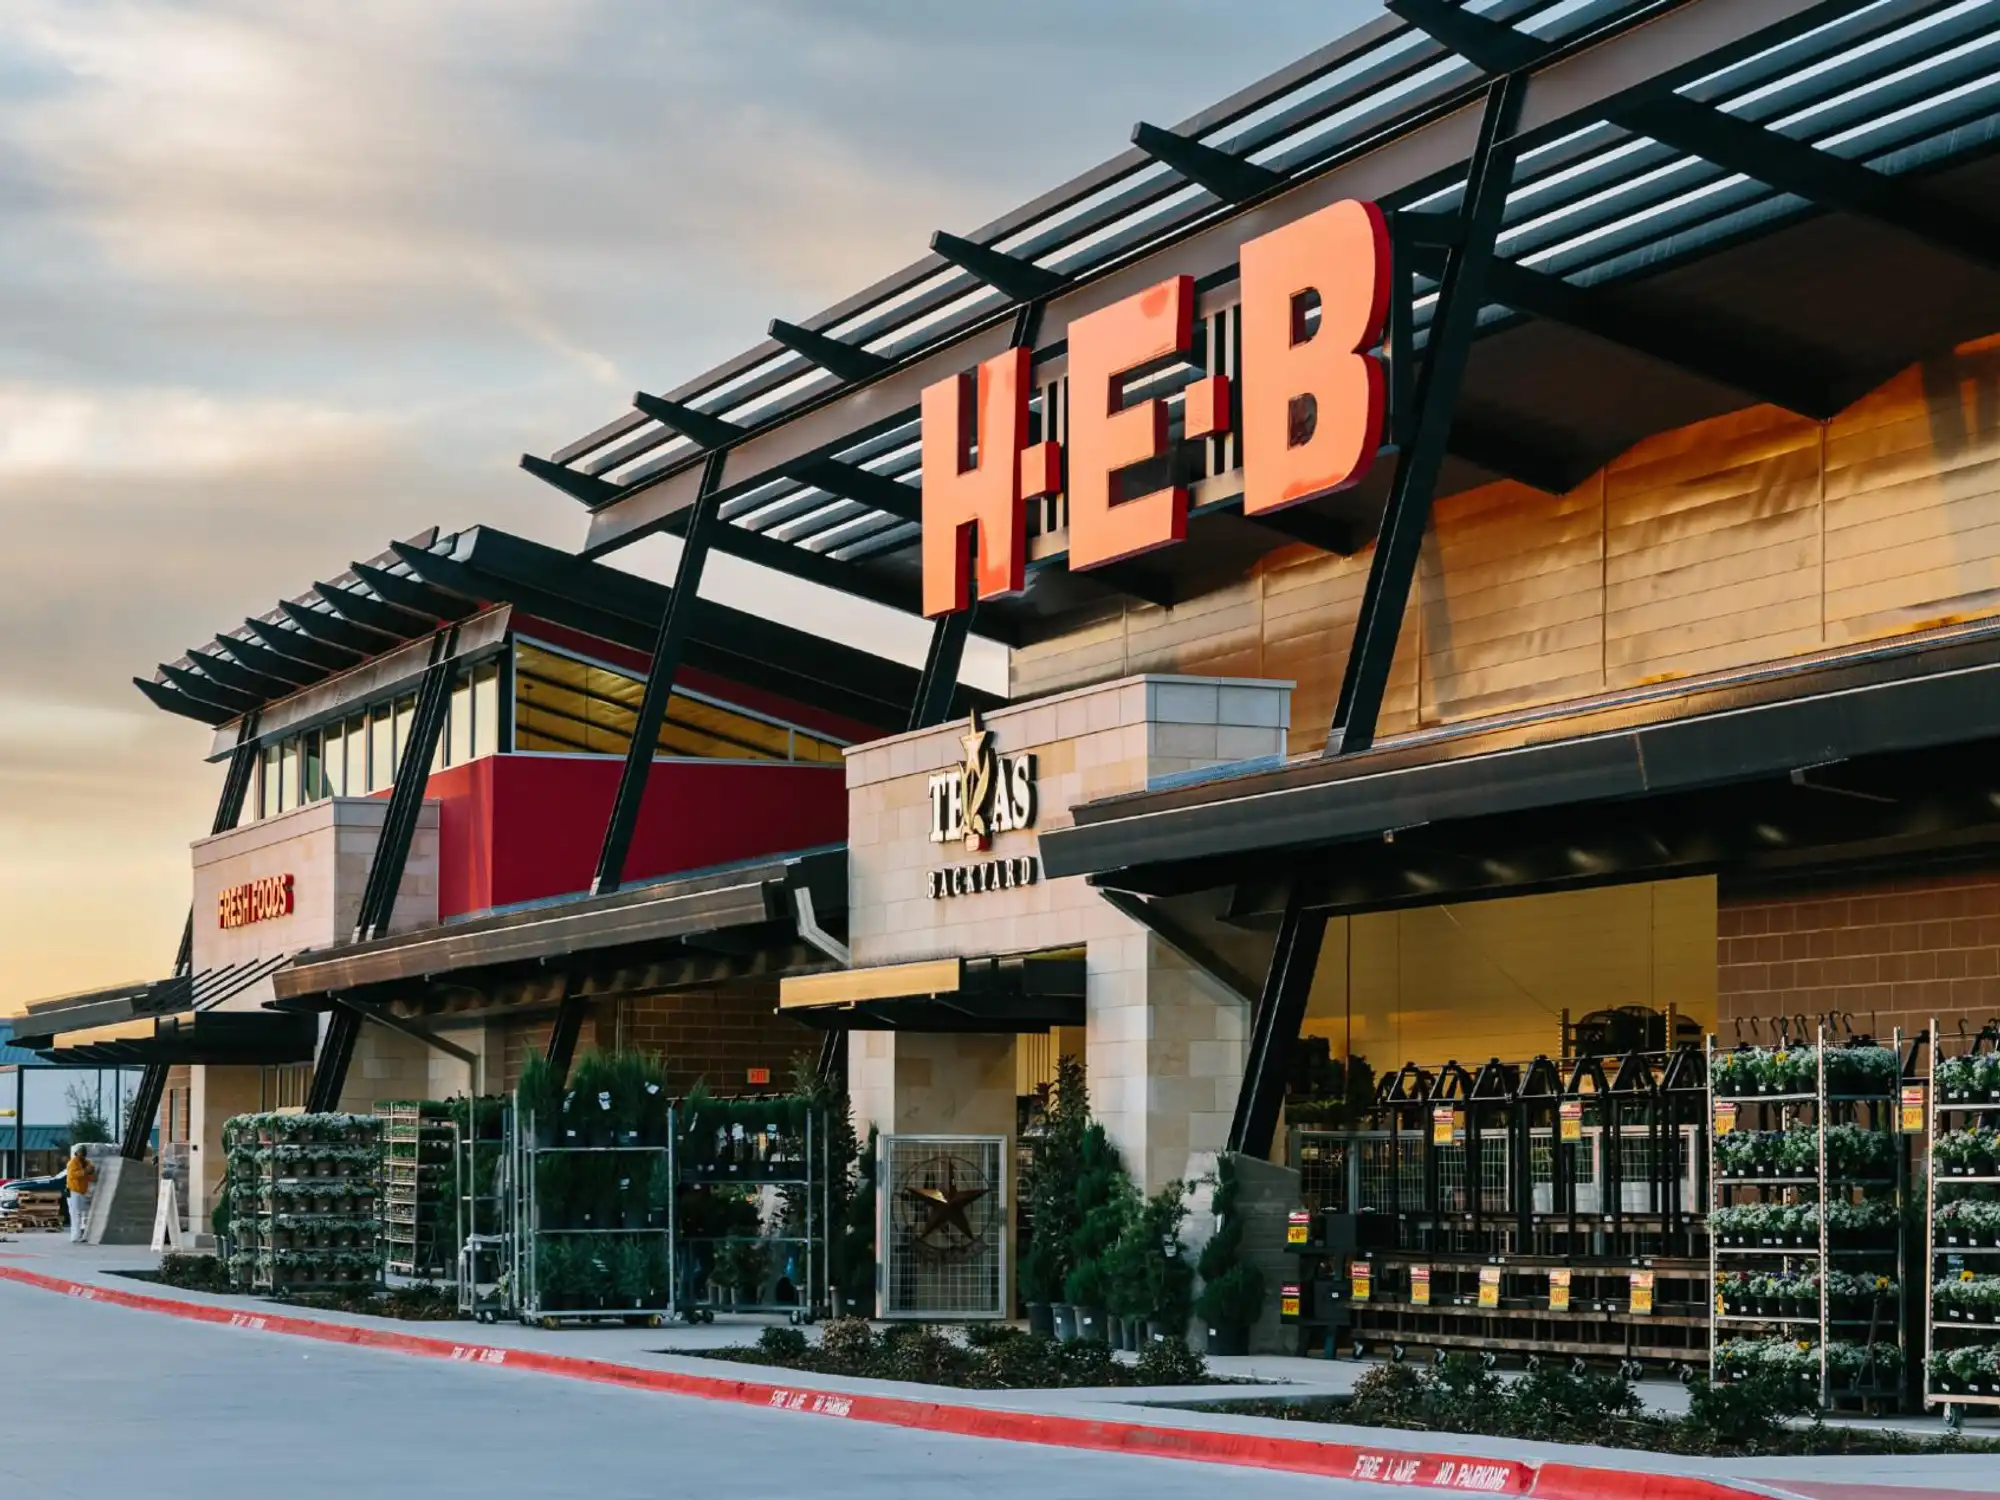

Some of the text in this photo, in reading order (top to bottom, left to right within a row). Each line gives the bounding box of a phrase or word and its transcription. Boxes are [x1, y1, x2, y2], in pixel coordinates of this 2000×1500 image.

[929, 748, 1037, 850] TEXAS
[218, 874, 294, 929] FRESH FOODS
[927, 856, 1038, 899] BACKYARD
[1351, 1454, 1510, 1490] FIRE LANE NO PARKING
